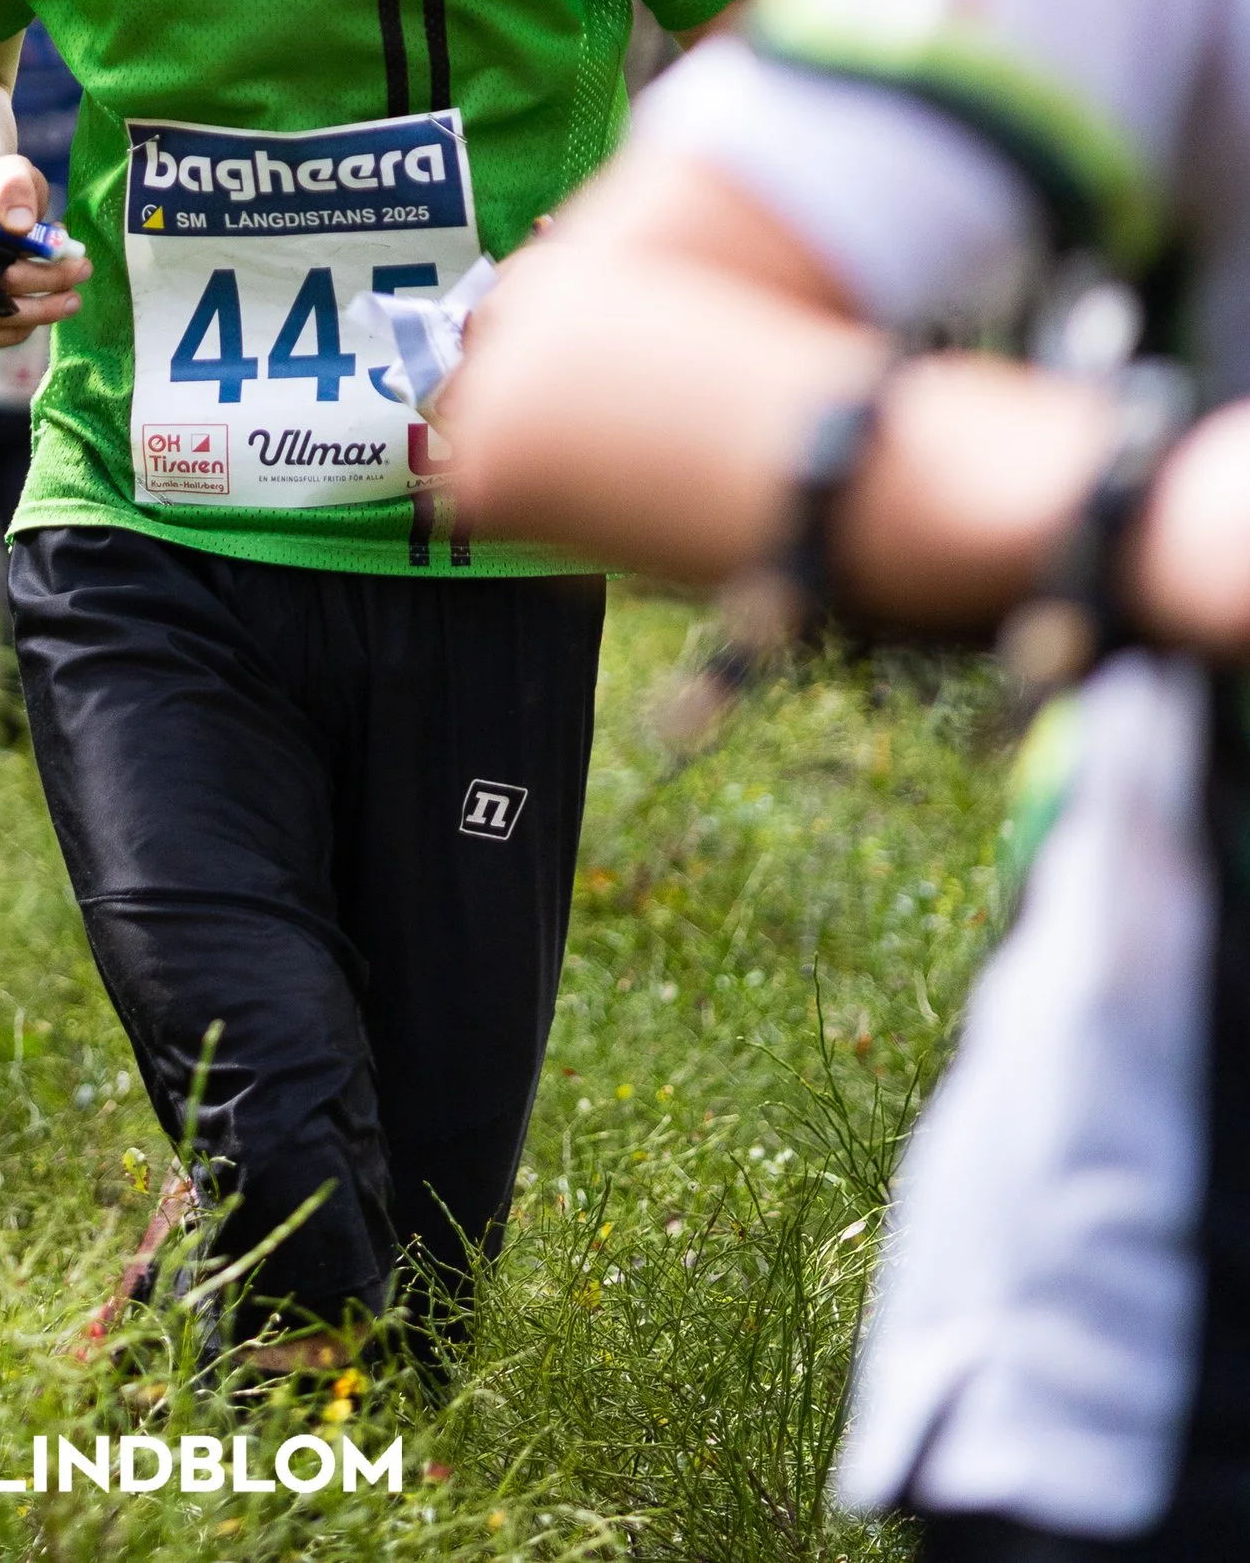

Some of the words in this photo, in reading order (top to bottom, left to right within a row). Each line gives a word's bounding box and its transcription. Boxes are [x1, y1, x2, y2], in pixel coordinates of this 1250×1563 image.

[143, 141, 447, 201] bagheera
[176, 211, 207, 228] SM
[225, 207, 376, 228] LÅNGDISTANS
[382, 205, 430, 222] 2025
[248, 429, 386, 466] Ullmax
[149, 455, 224, 473] Tisaren
[270, 475, 321, 483] MENINGSFULL
[323, 474, 347, 482] FRITID
[350, 473, 363, 481] FÖR
